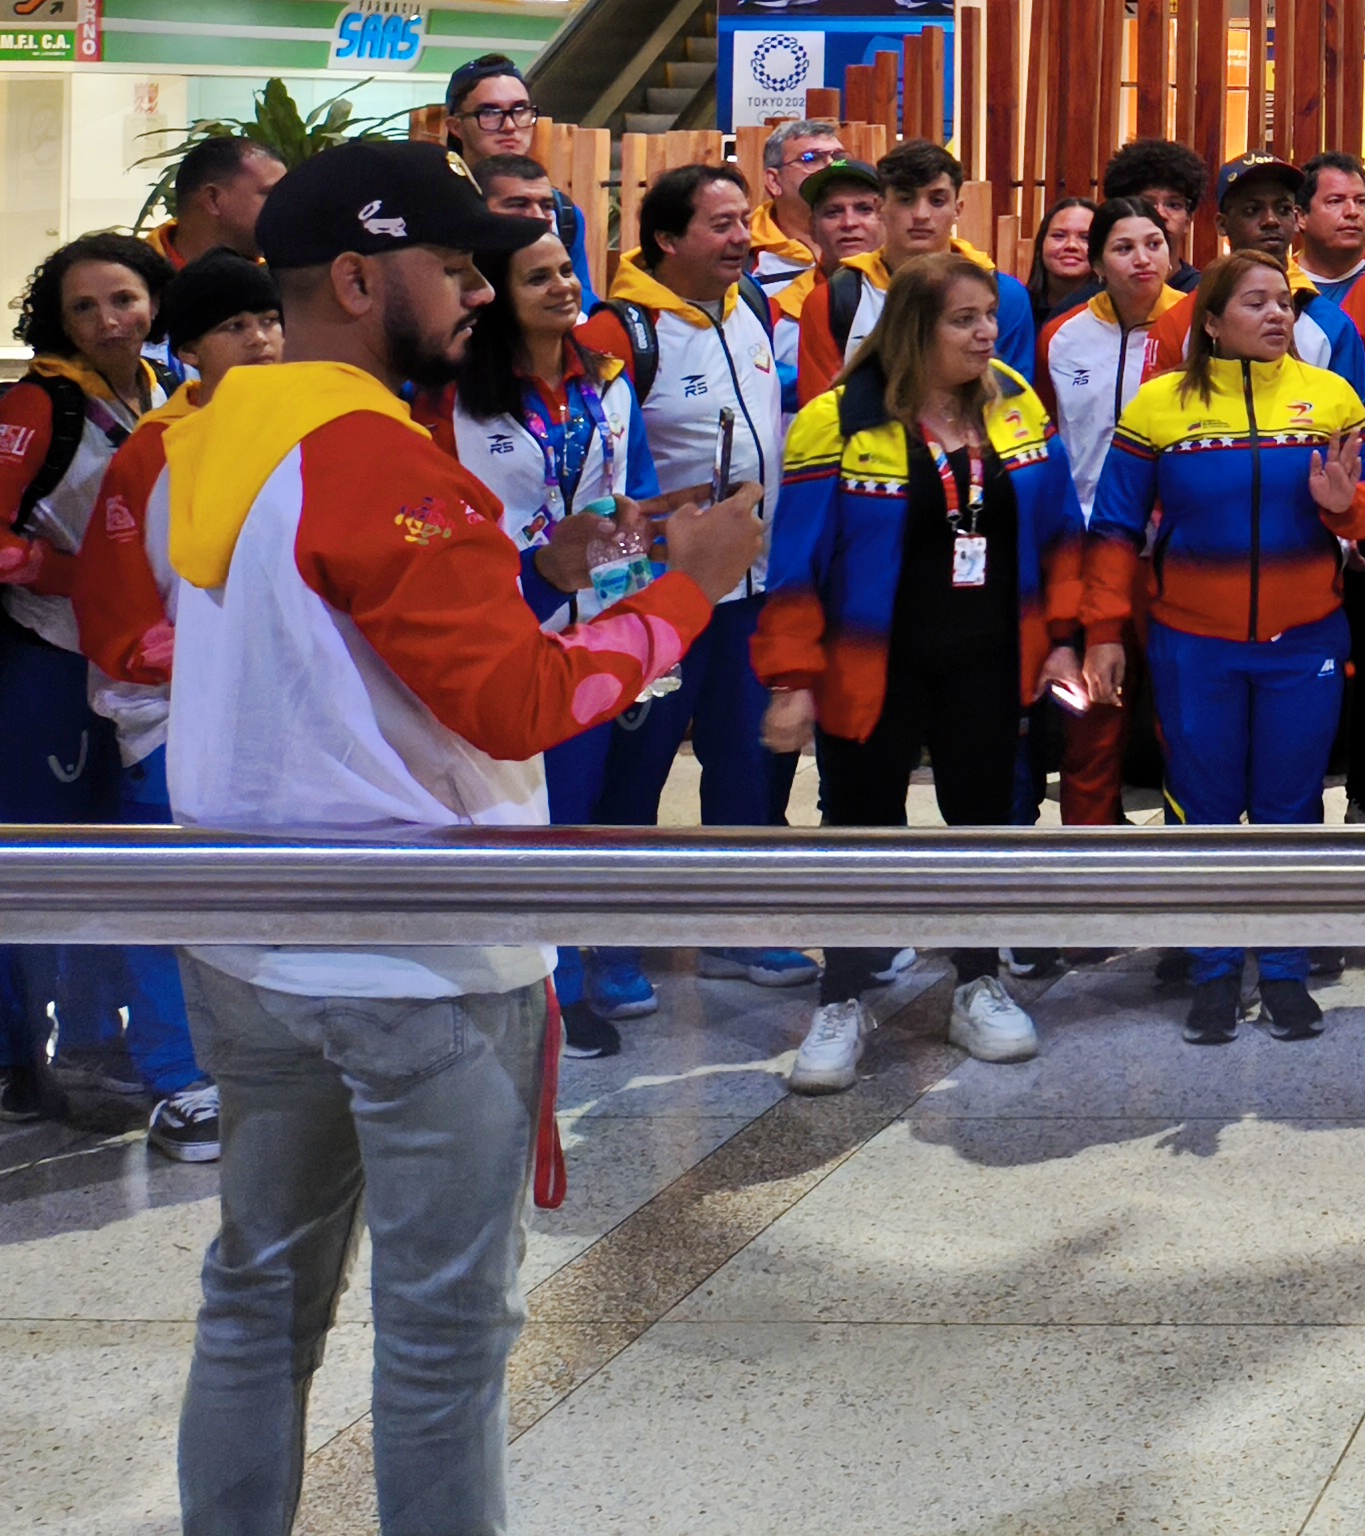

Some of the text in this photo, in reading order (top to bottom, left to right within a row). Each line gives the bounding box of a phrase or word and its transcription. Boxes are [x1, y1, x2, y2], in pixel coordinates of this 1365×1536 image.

[41, 34, 71, 49] C.A.
[336, 12, 422, 61] SAAS
[747, 96, 806, 108] TOKYO 202
